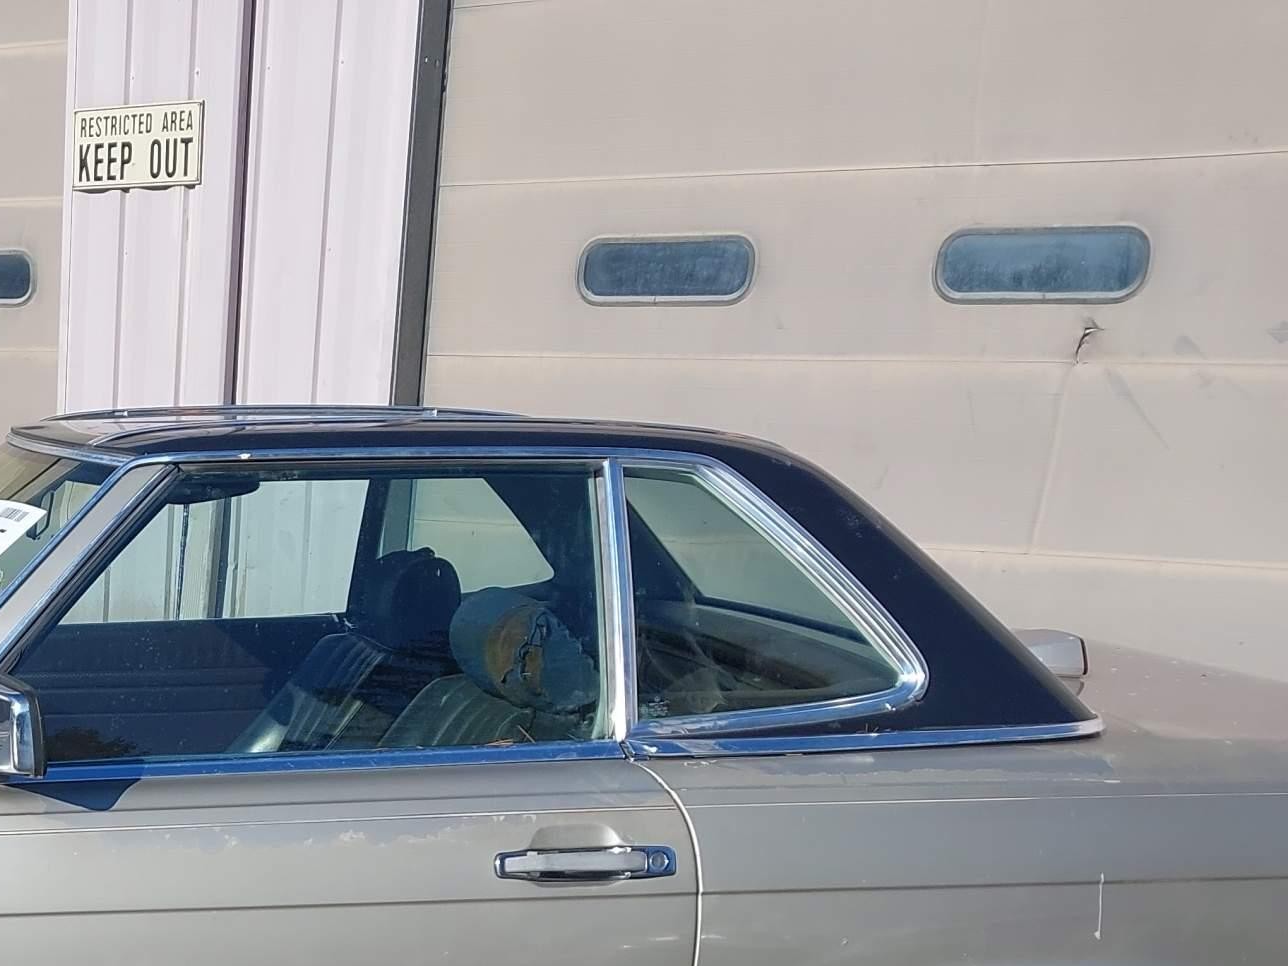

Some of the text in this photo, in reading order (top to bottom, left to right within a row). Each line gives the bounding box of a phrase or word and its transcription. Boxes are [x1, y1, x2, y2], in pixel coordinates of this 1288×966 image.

[80, 110, 193, 138] RESTRICTED AREA
[78, 137, 194, 182] KEEP OUT
